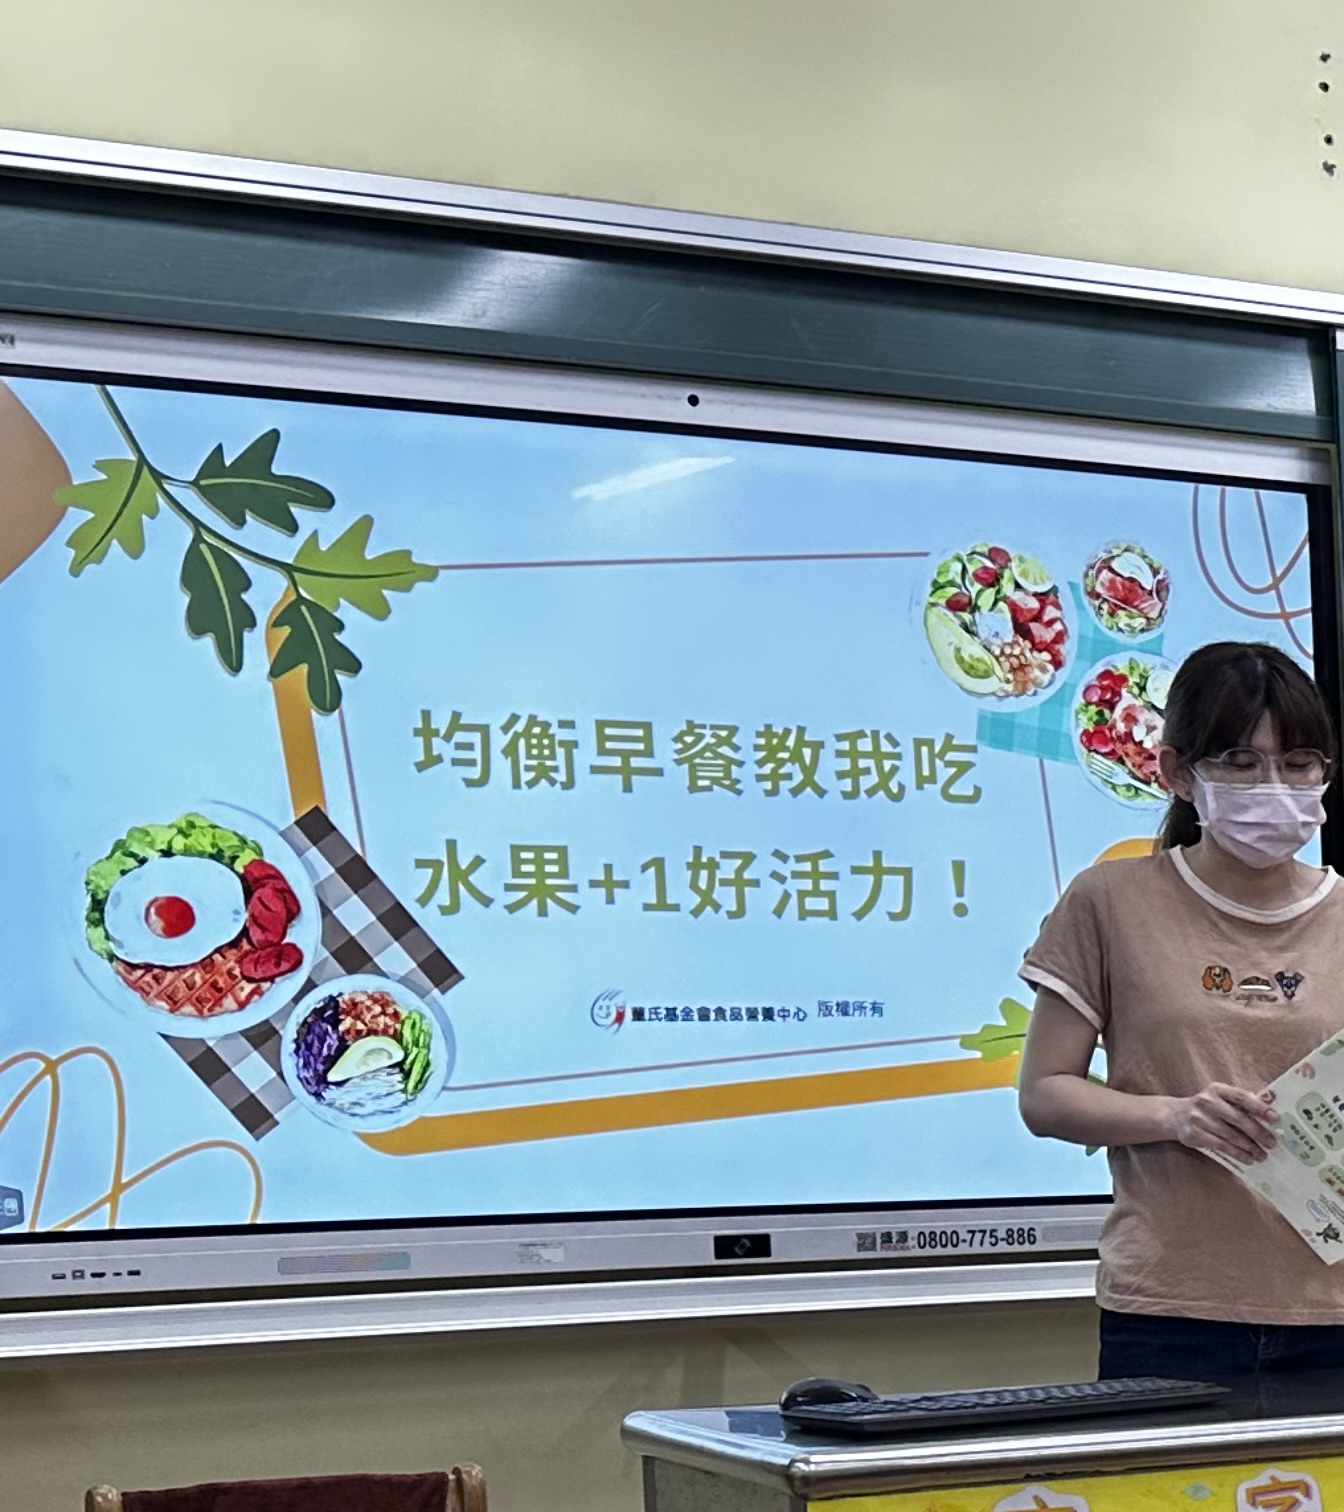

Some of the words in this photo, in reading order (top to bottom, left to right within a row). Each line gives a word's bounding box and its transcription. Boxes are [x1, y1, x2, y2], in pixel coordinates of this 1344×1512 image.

[412, 708, 983, 804] 均衡早餐教我吃
[917, 1227, 1037, 1250] 0800-775-886
